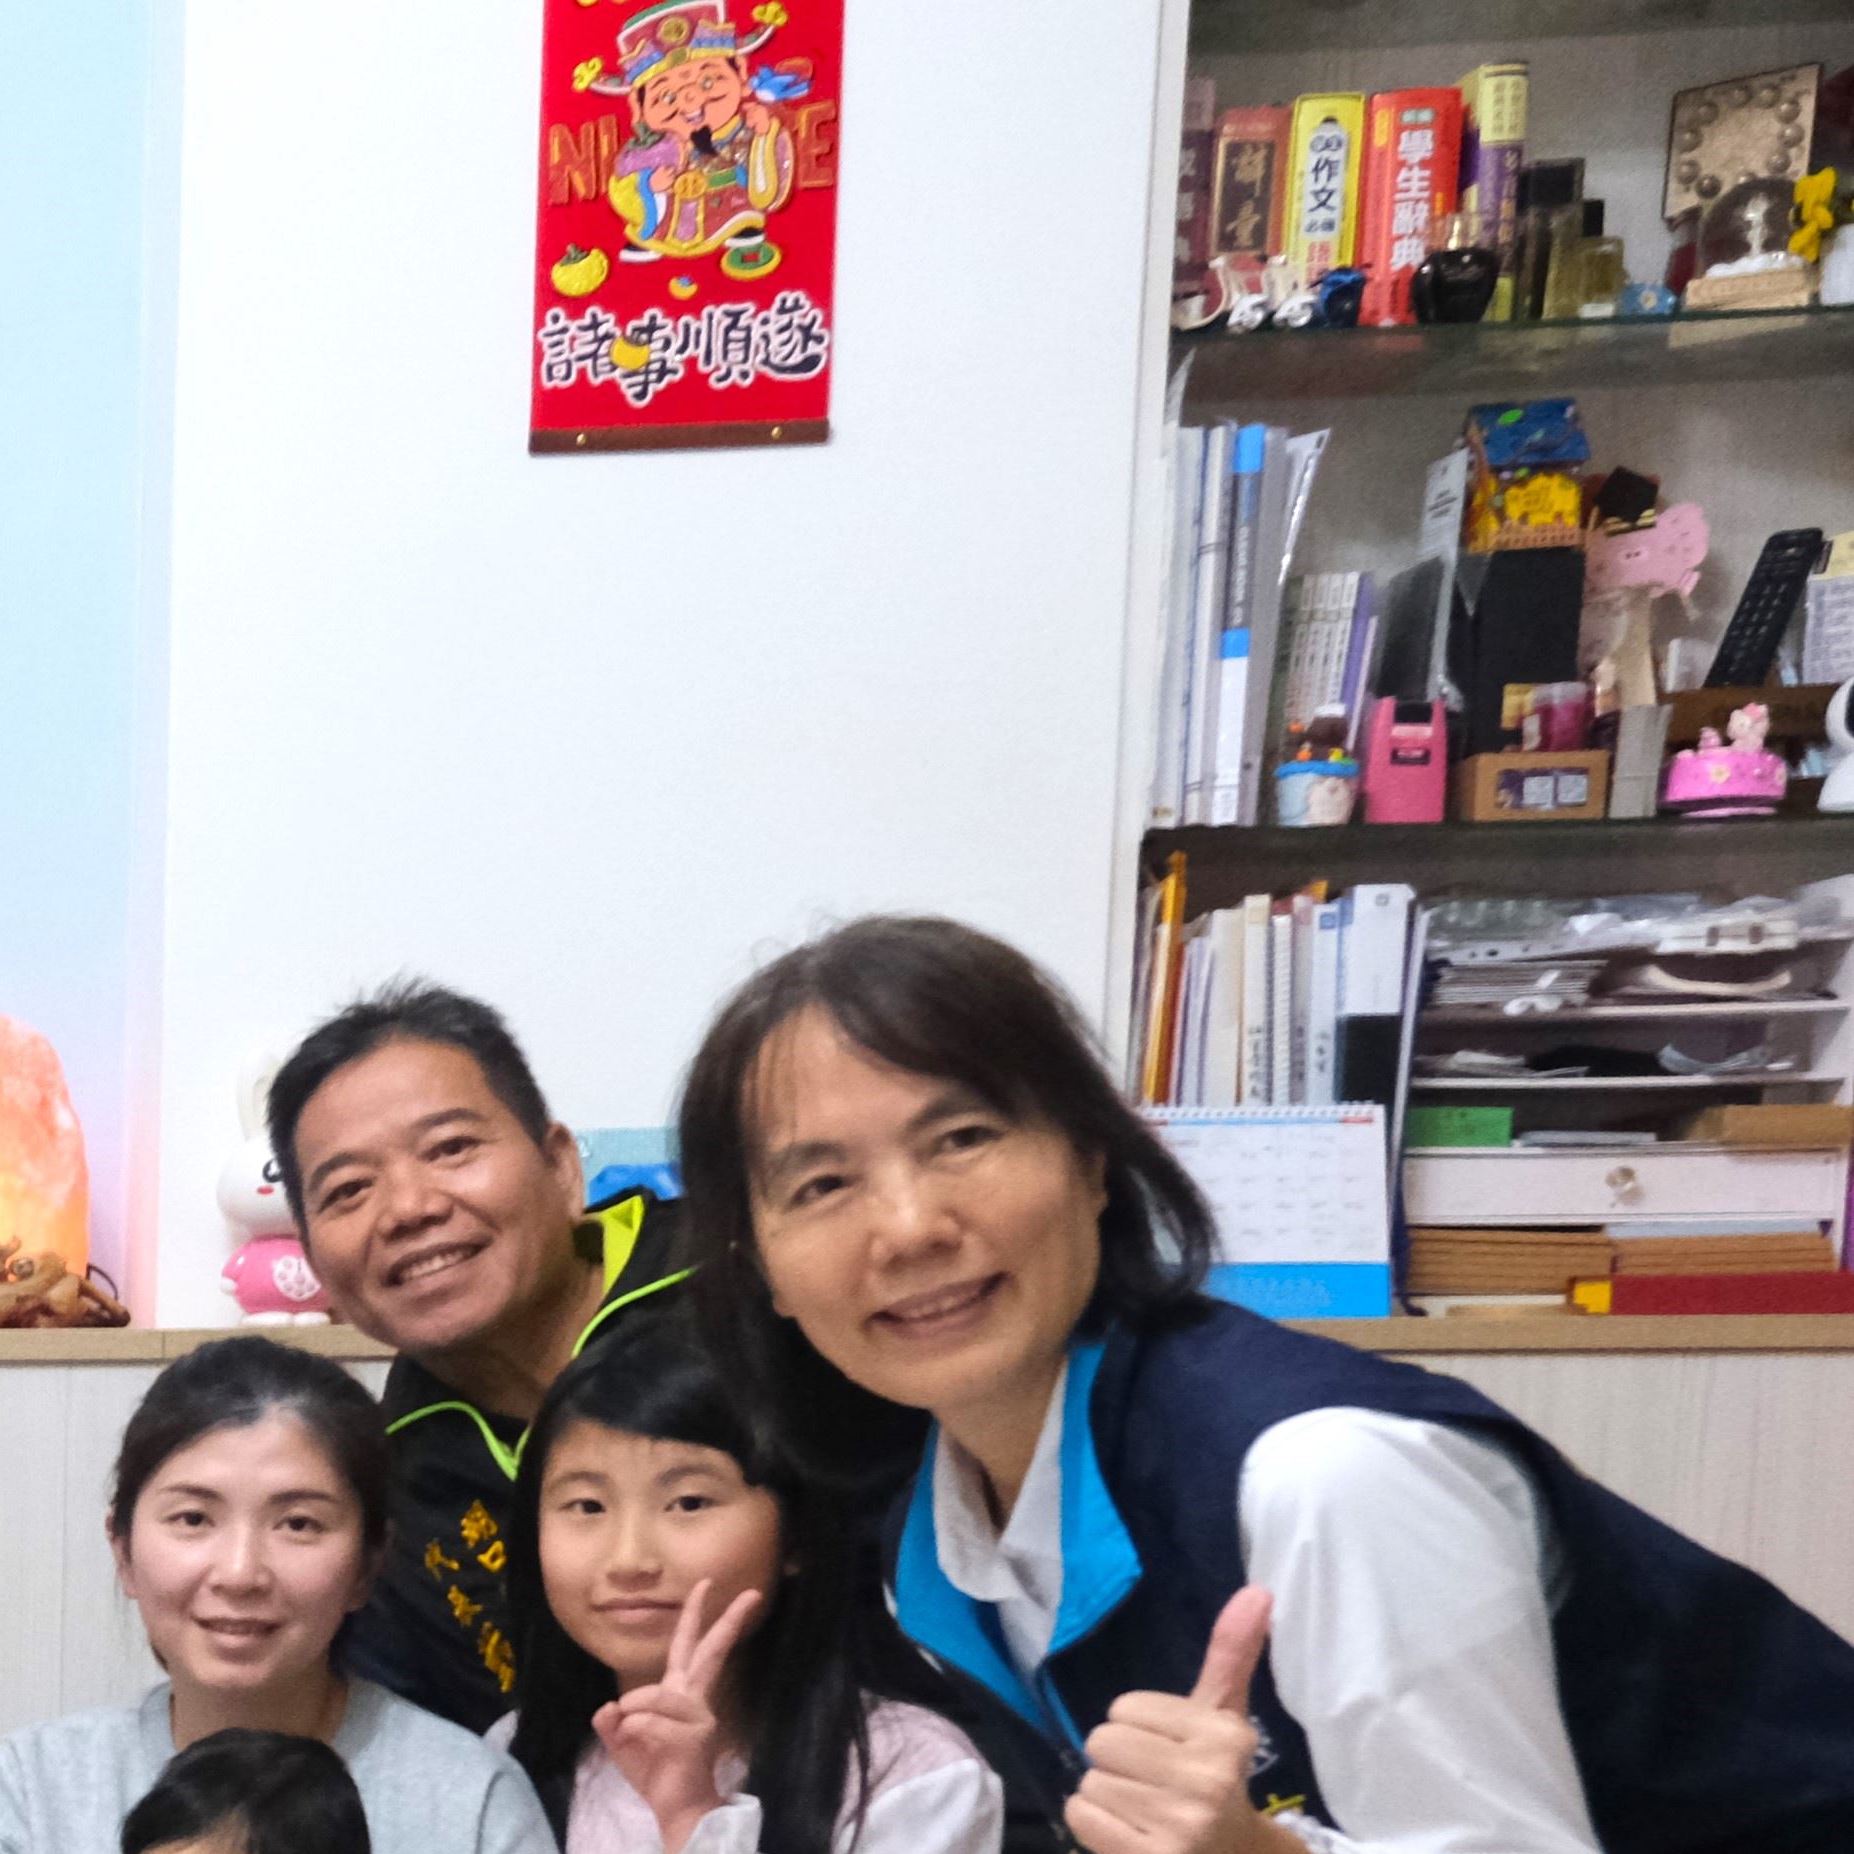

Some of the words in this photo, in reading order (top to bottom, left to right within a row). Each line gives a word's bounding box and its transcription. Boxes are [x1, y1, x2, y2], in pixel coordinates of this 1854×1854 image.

[548, 100, 837, 205] NIE
[538, 292, 826, 406] 諸事順遂
